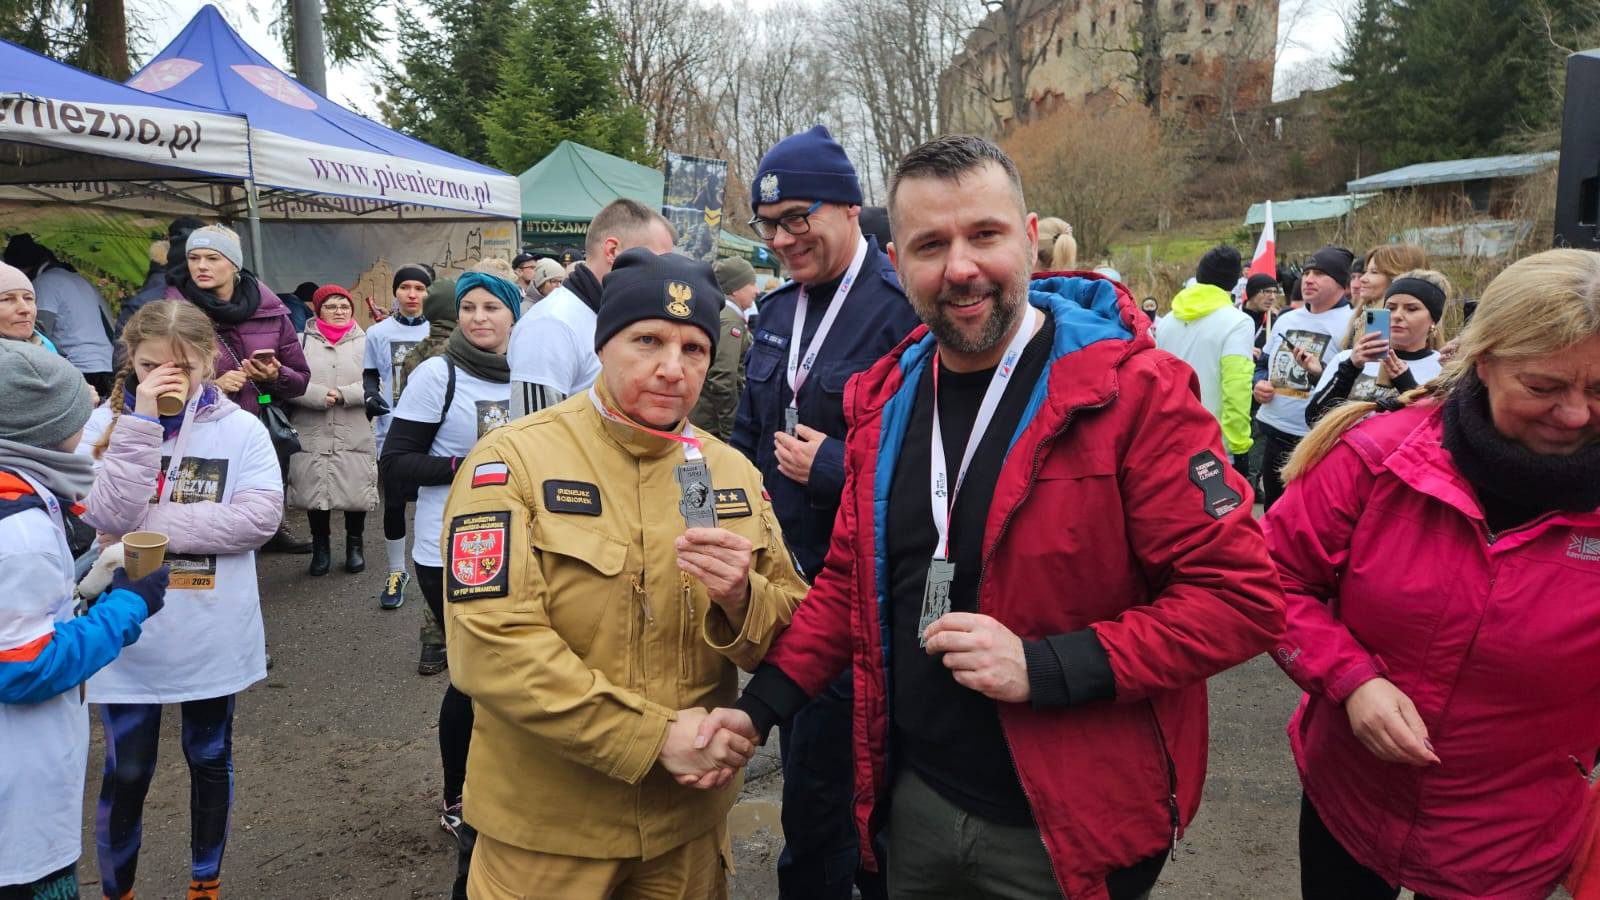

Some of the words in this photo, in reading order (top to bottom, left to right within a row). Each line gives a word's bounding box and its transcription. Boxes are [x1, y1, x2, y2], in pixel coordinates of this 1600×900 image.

[308, 157, 491, 210] www.pieniezno.pl
[525, 217, 590, 235] #TOŻSAM
[191, 578, 211, 586] 2025
